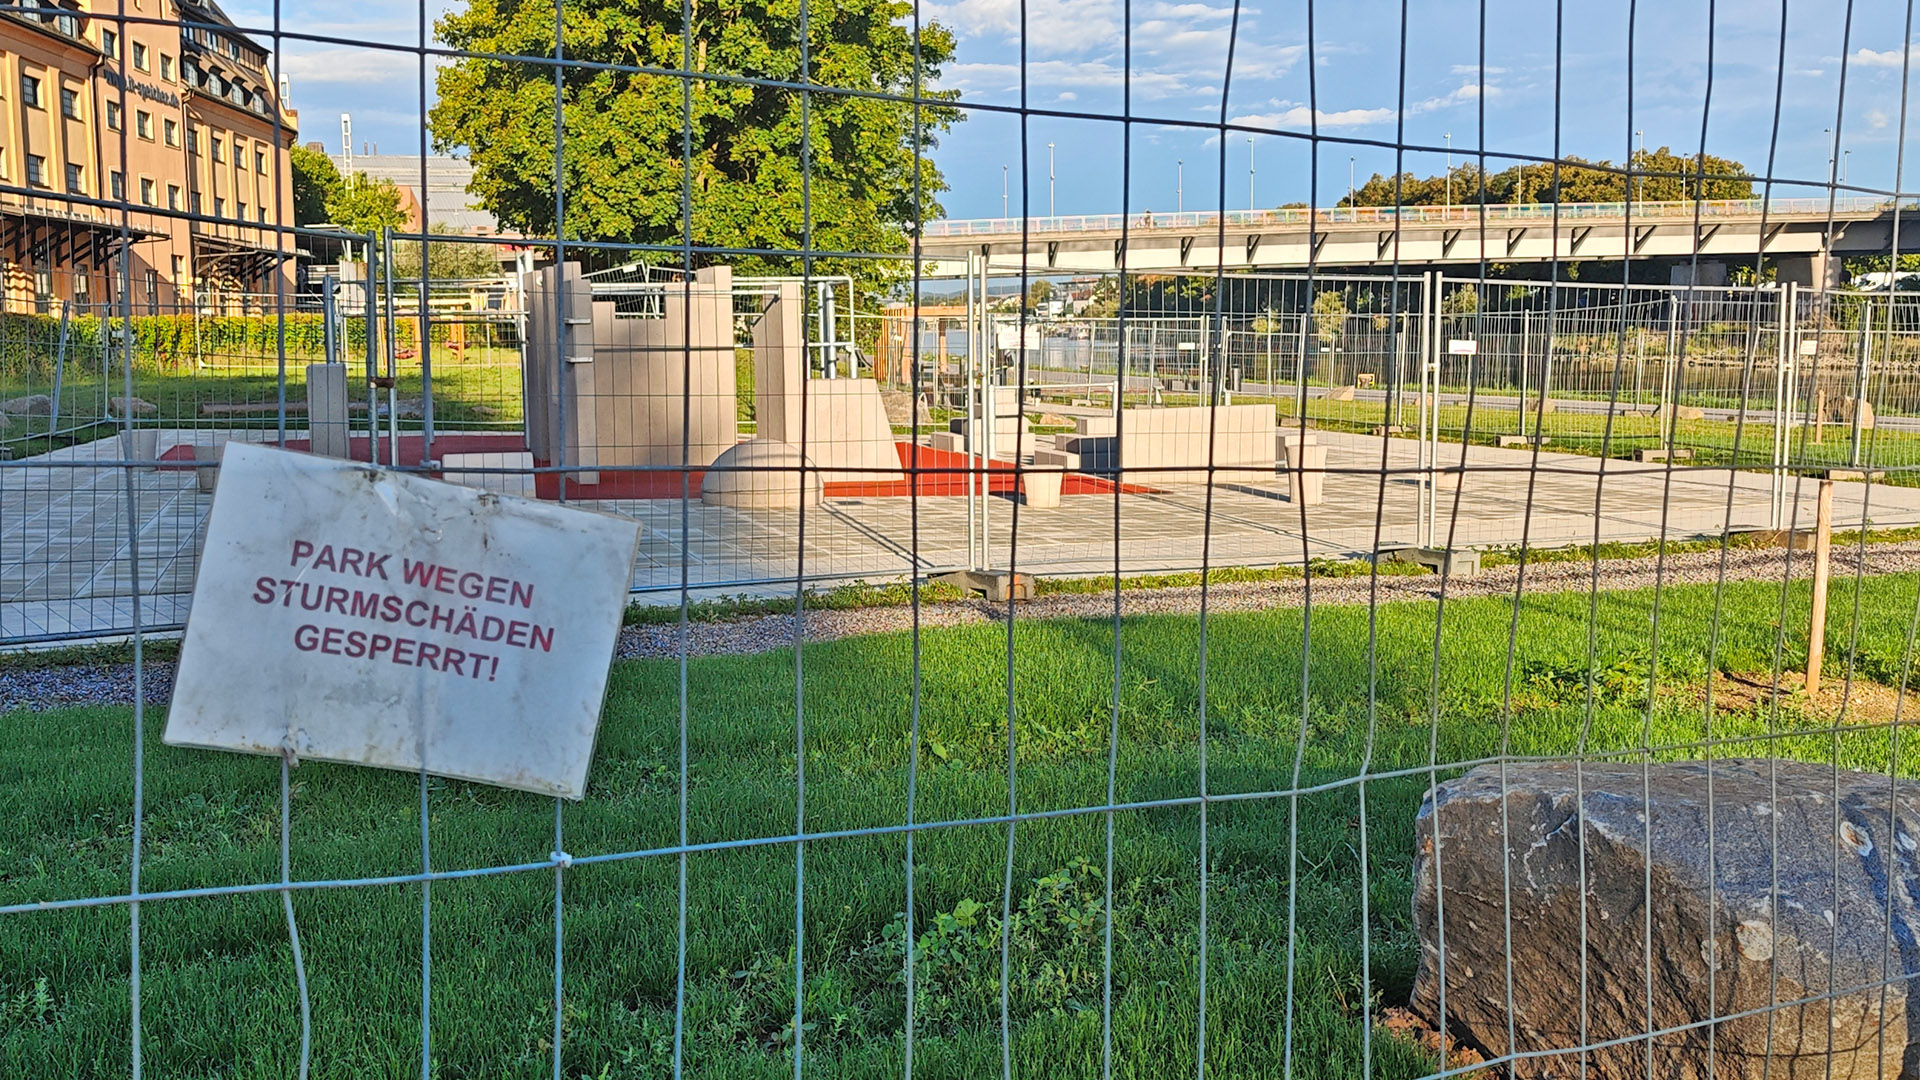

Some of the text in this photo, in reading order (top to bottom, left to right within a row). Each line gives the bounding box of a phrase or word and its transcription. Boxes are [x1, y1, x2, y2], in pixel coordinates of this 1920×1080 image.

[104, 69, 180, 110] ww.it-speicher.de
[290, 540, 534, 608] PARK WEGEN
[253, 576, 555, 652] STURMSCHÄDEN
[294, 624, 500, 682] GESPERRT!
